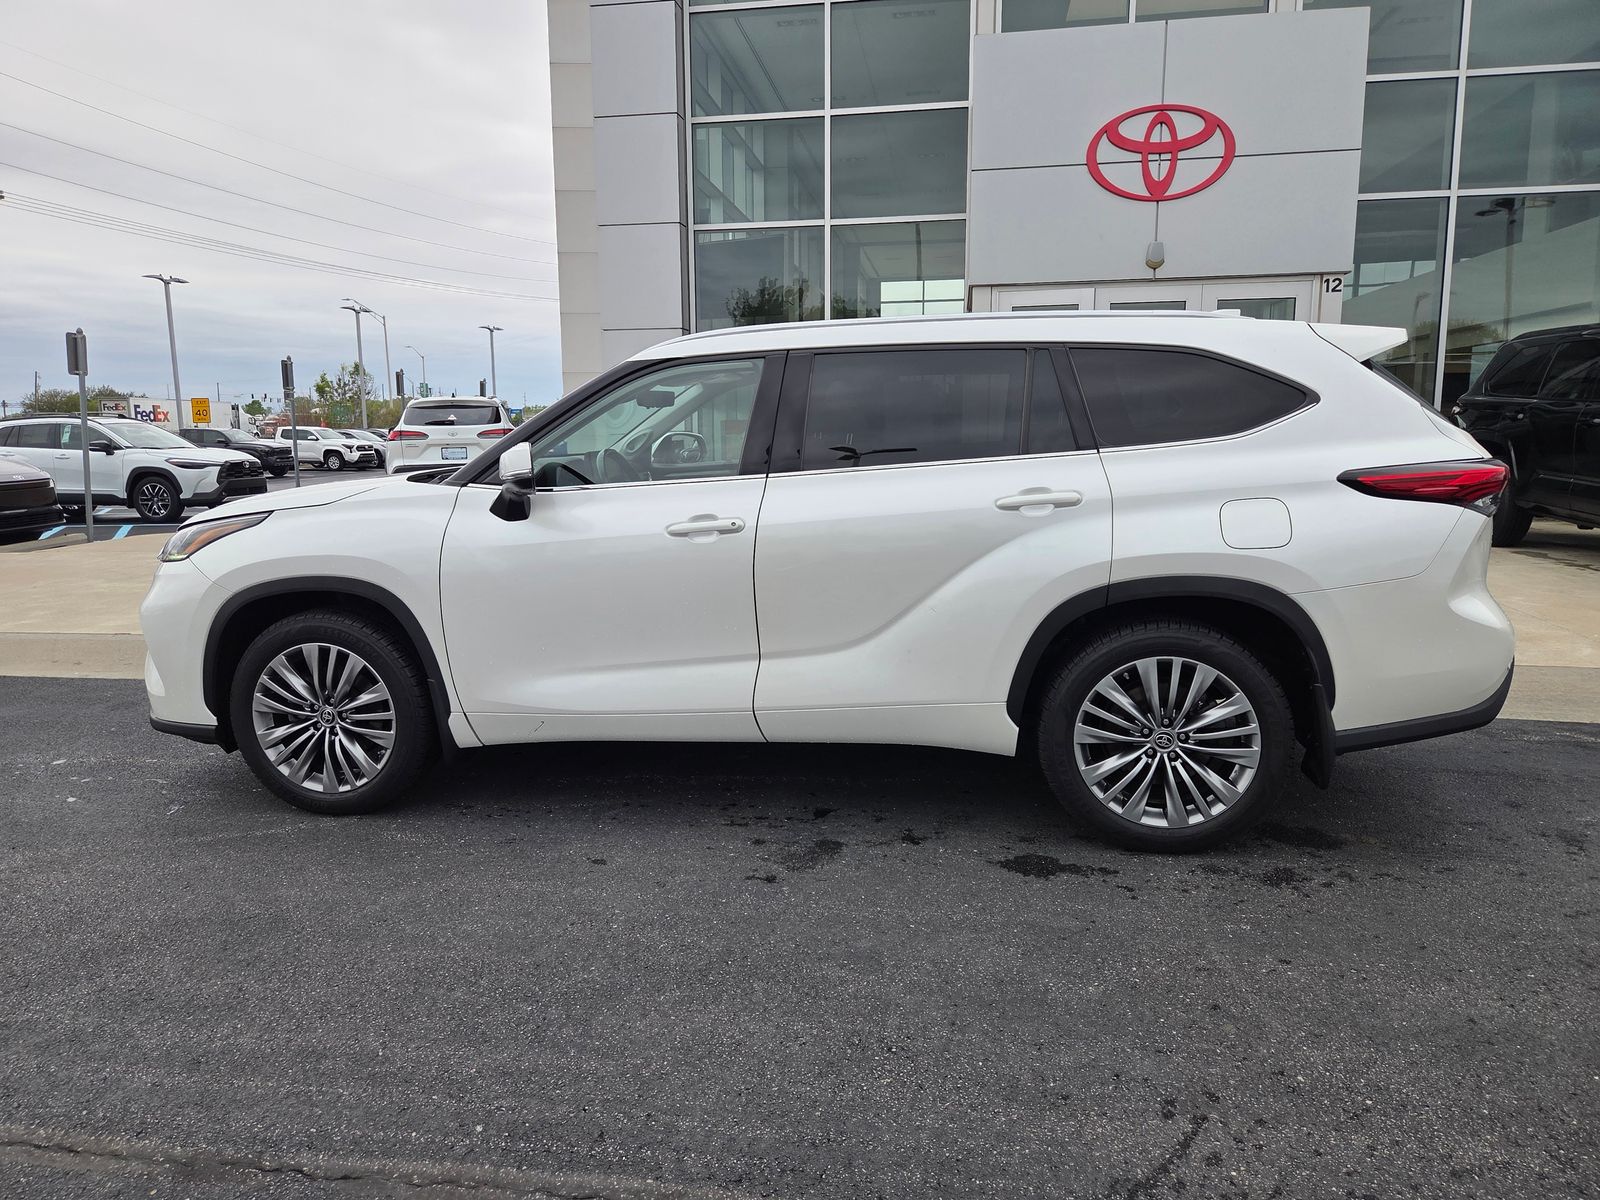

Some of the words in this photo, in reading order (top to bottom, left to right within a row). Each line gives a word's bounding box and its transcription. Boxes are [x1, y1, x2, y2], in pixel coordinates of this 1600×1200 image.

[1324, 278, 1342, 293] 12
[103, 403, 126, 411] FedEx
[134, 404, 170, 422] FedEx
